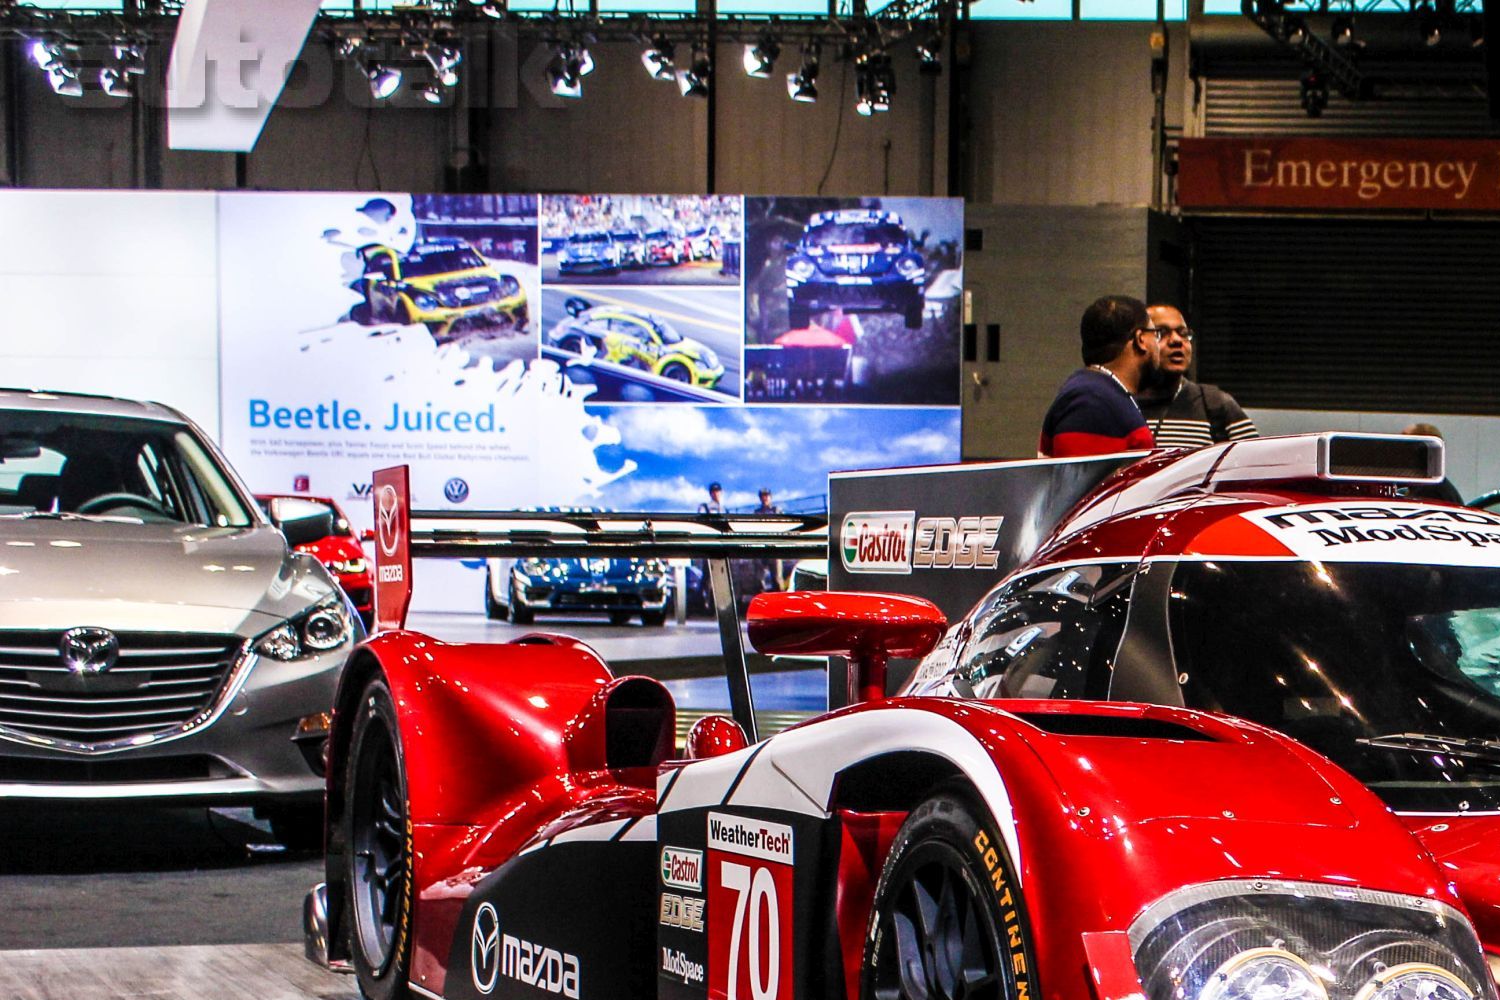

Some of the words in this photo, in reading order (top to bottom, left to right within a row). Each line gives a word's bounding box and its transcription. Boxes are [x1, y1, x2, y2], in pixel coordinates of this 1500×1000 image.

[1243, 149, 1478, 199] Emergency
[249, 399, 371, 431] Beetle.
[383, 401, 506, 433] Juiced.
[858, 522, 908, 563] Castrol
[913, 516, 1004, 570] EDGE
[709, 819, 790, 854] WeatherTech
[671, 854, 699, 884] Castrol
[660, 892, 705, 933] EDGE
[662, 946, 704, 985] ModSpace
